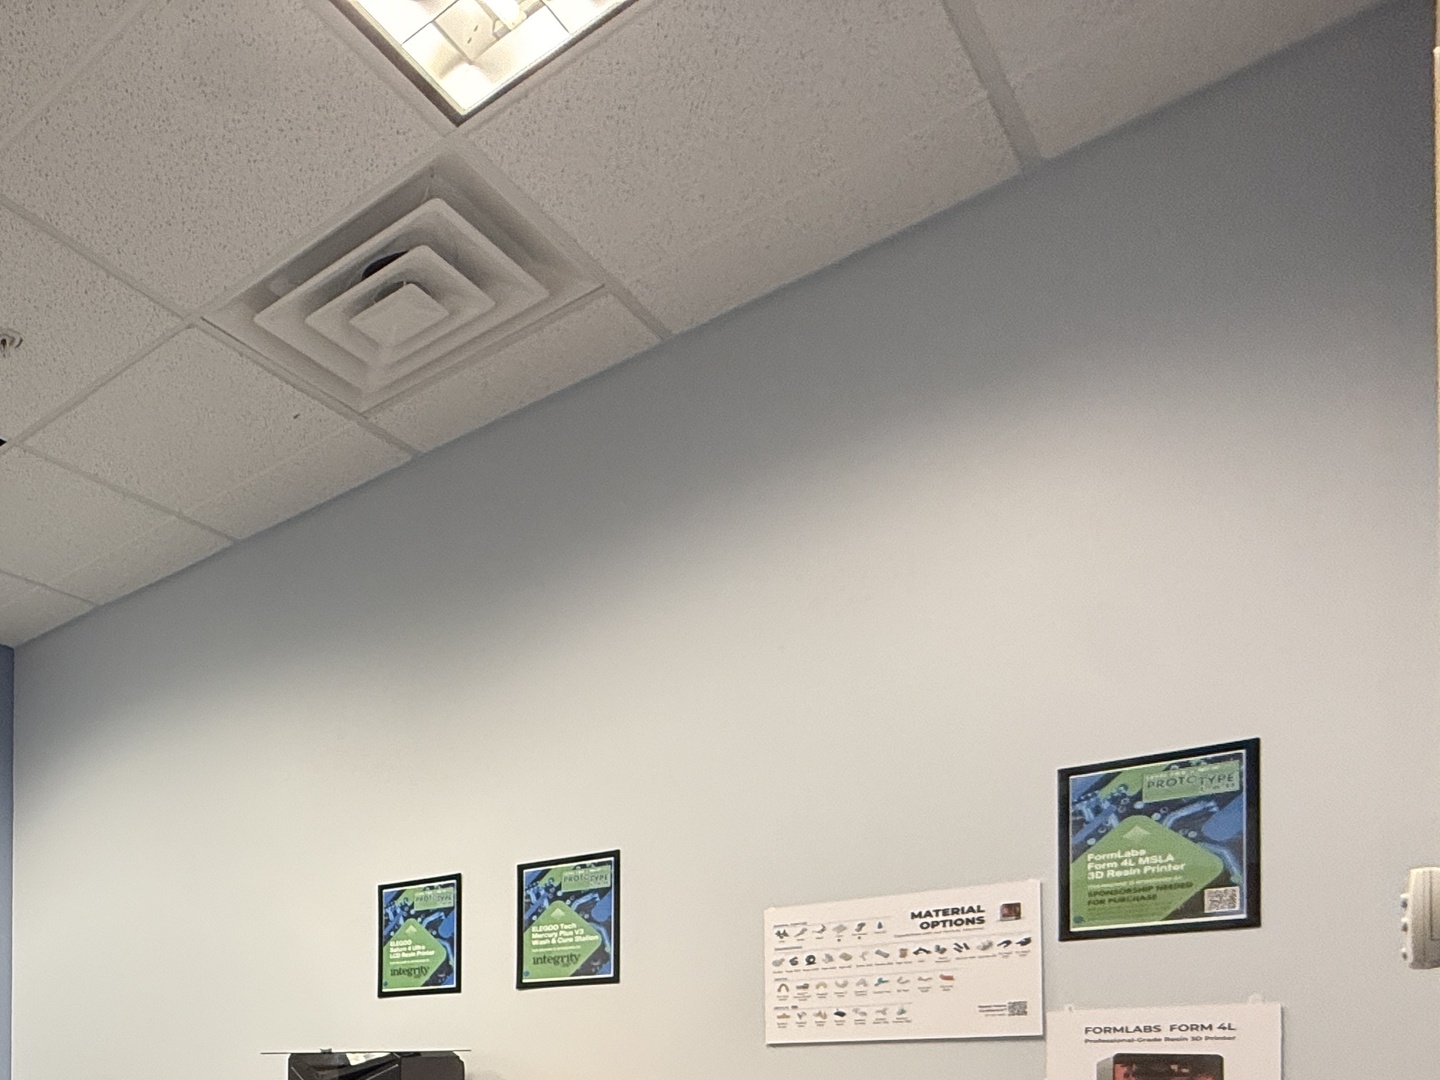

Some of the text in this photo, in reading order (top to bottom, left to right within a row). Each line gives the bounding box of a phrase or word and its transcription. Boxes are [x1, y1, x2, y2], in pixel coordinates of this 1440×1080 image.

[1087, 849, 1146, 862] FormLabs
[1087, 853, 1175, 871] Form 4L MSLA
[1087, 863, 1187, 880] 3D Resin Printer
[910, 904, 986, 920] MATERIAL
[531, 924, 559, 933] ELEGOO
[919, 916, 986, 930] OPTIONS
[1084, 1022, 1237, 1035] FORMLABS FORM 4L
